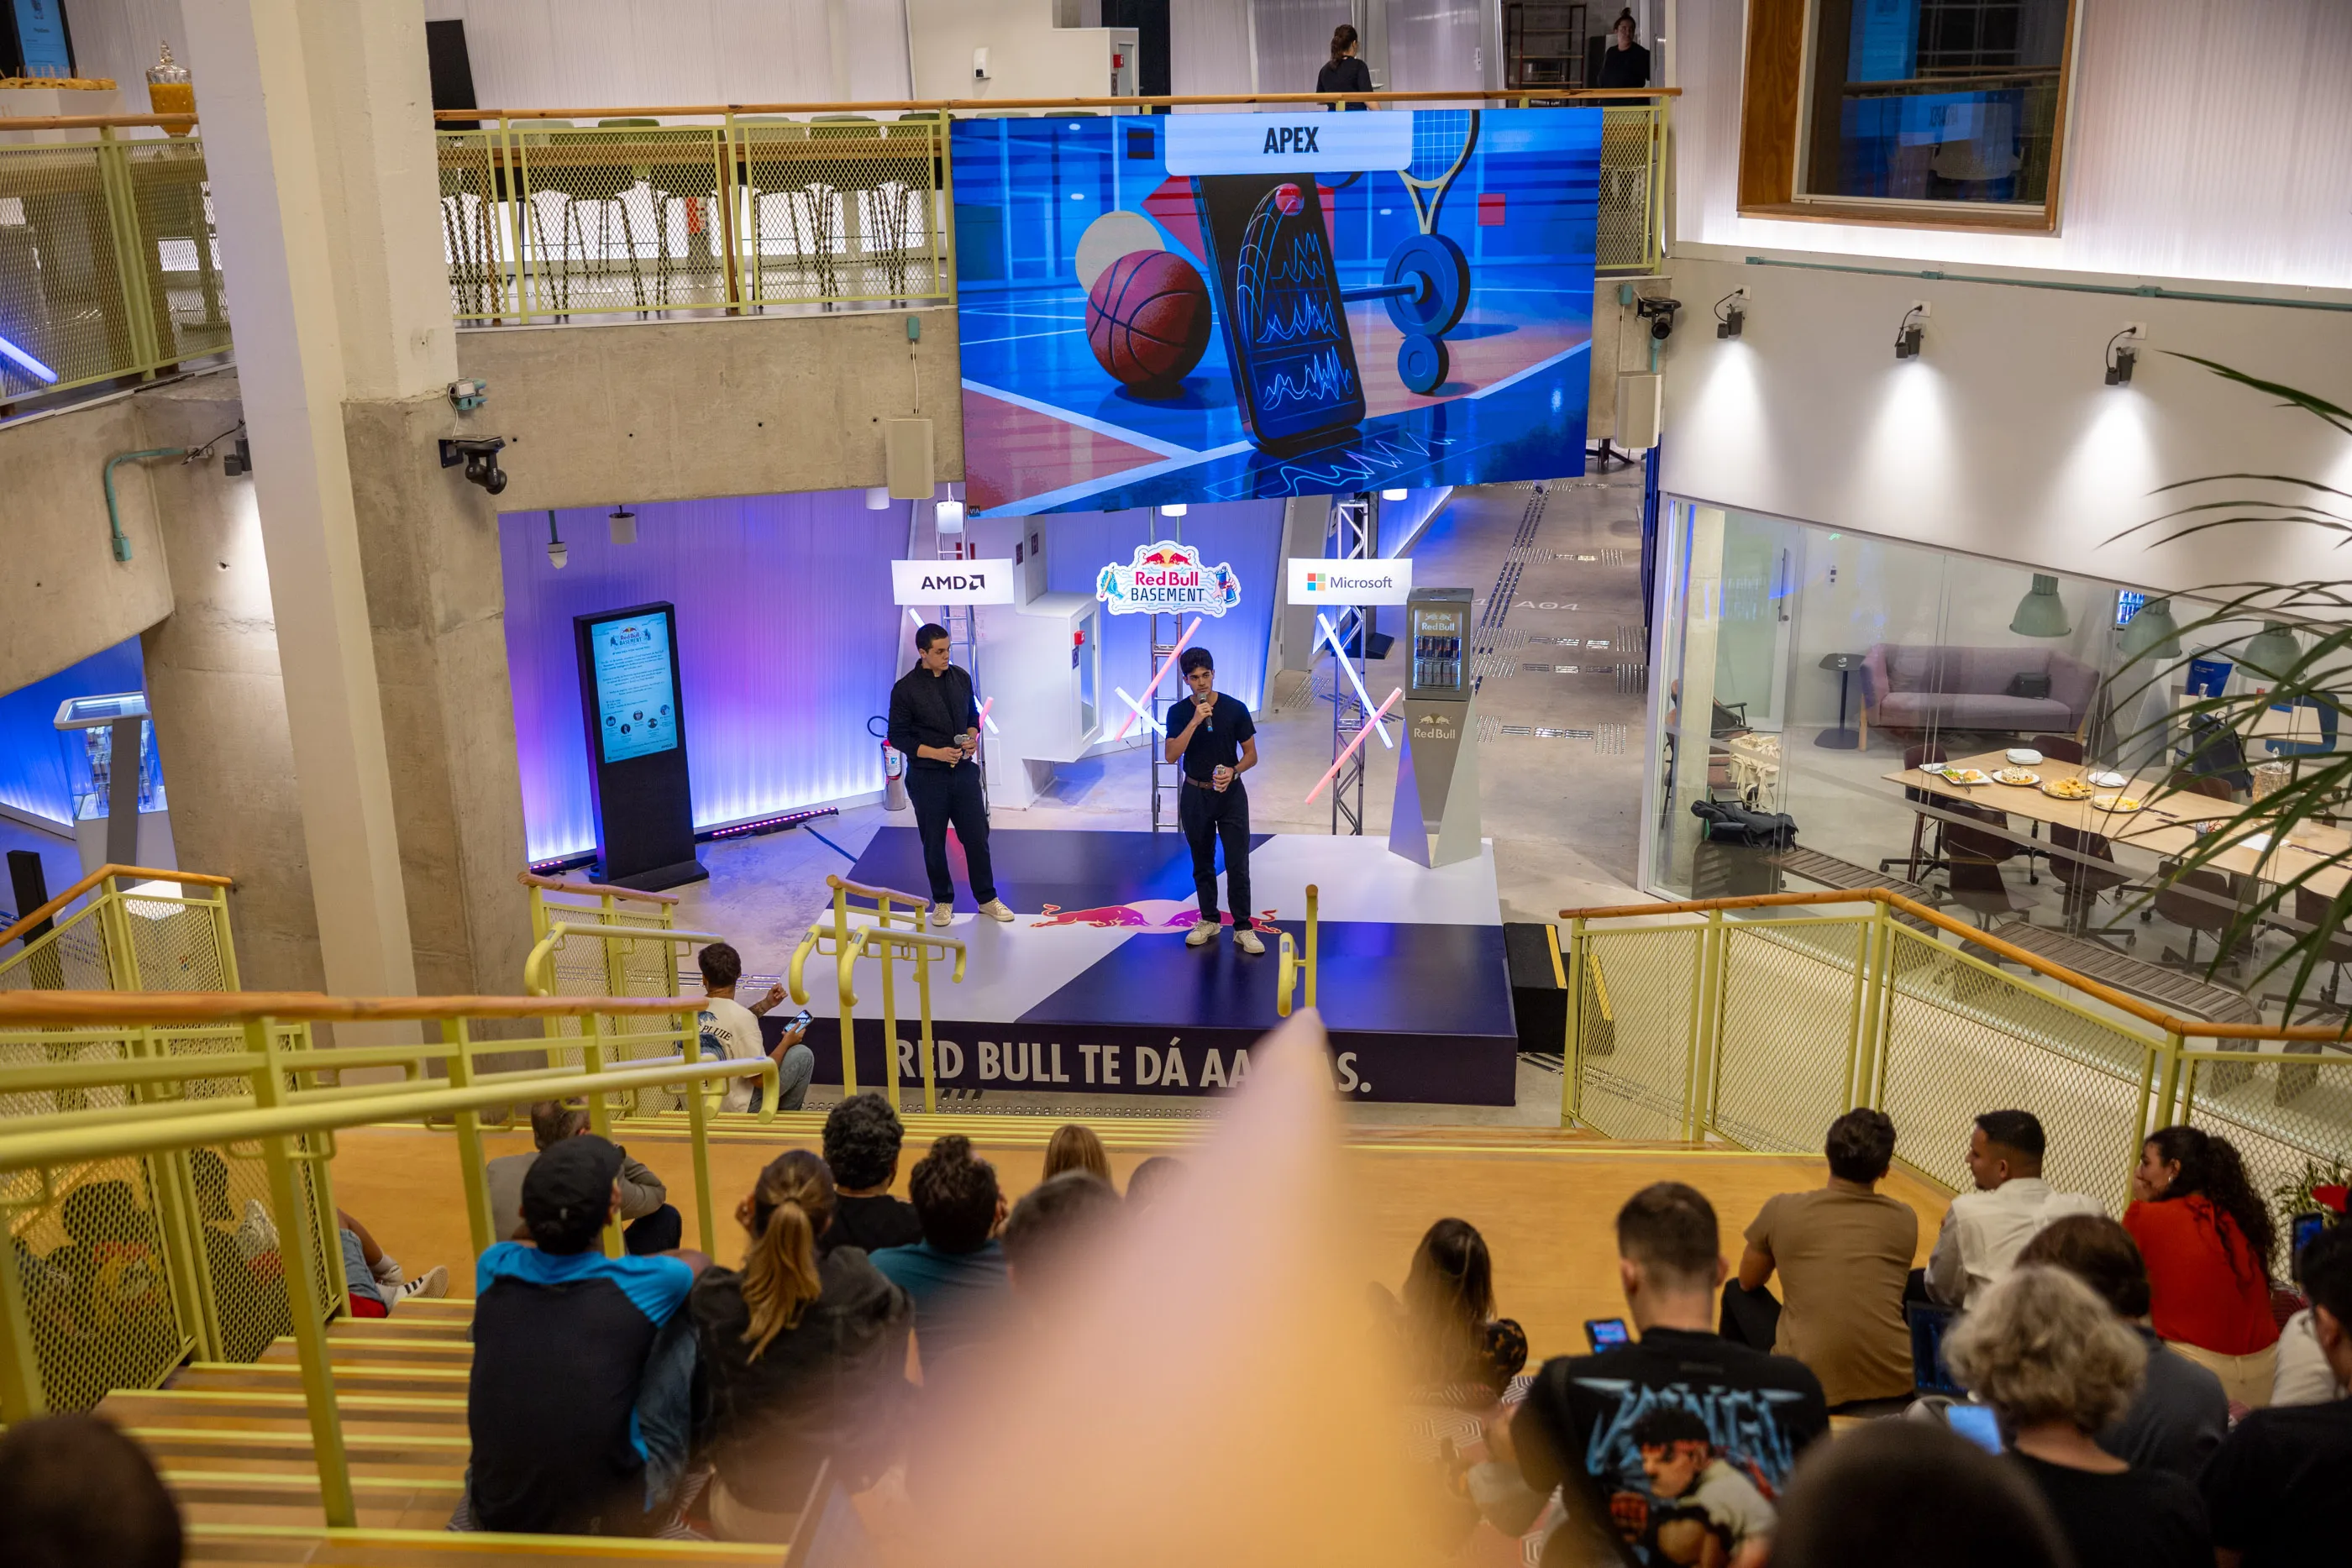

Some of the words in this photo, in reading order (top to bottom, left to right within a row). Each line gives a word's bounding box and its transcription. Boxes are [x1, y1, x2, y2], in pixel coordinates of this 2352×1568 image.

[1263, 126, 1320, 155] APEX
[921, 575, 968, 590] AMD
[1135, 570, 1166, 586] Red
[1168, 571, 1199, 586] Bull
[1330, 575, 1393, 589] Microsoft
[1131, 587, 1205, 602] BASEMENT
[1421, 621, 1438, 631] Red
[1438, 622, 1455, 632] Bull
[1414, 727, 1435, 738] Red
[1436, 728, 1456, 739] Bull
[701, 1025, 733, 1041] PLUIE
[978, 1041, 1069, 1083] BULL
[1079, 1044, 1121, 1085] TE
[1136, 1036, 1189, 1087] DÁ
